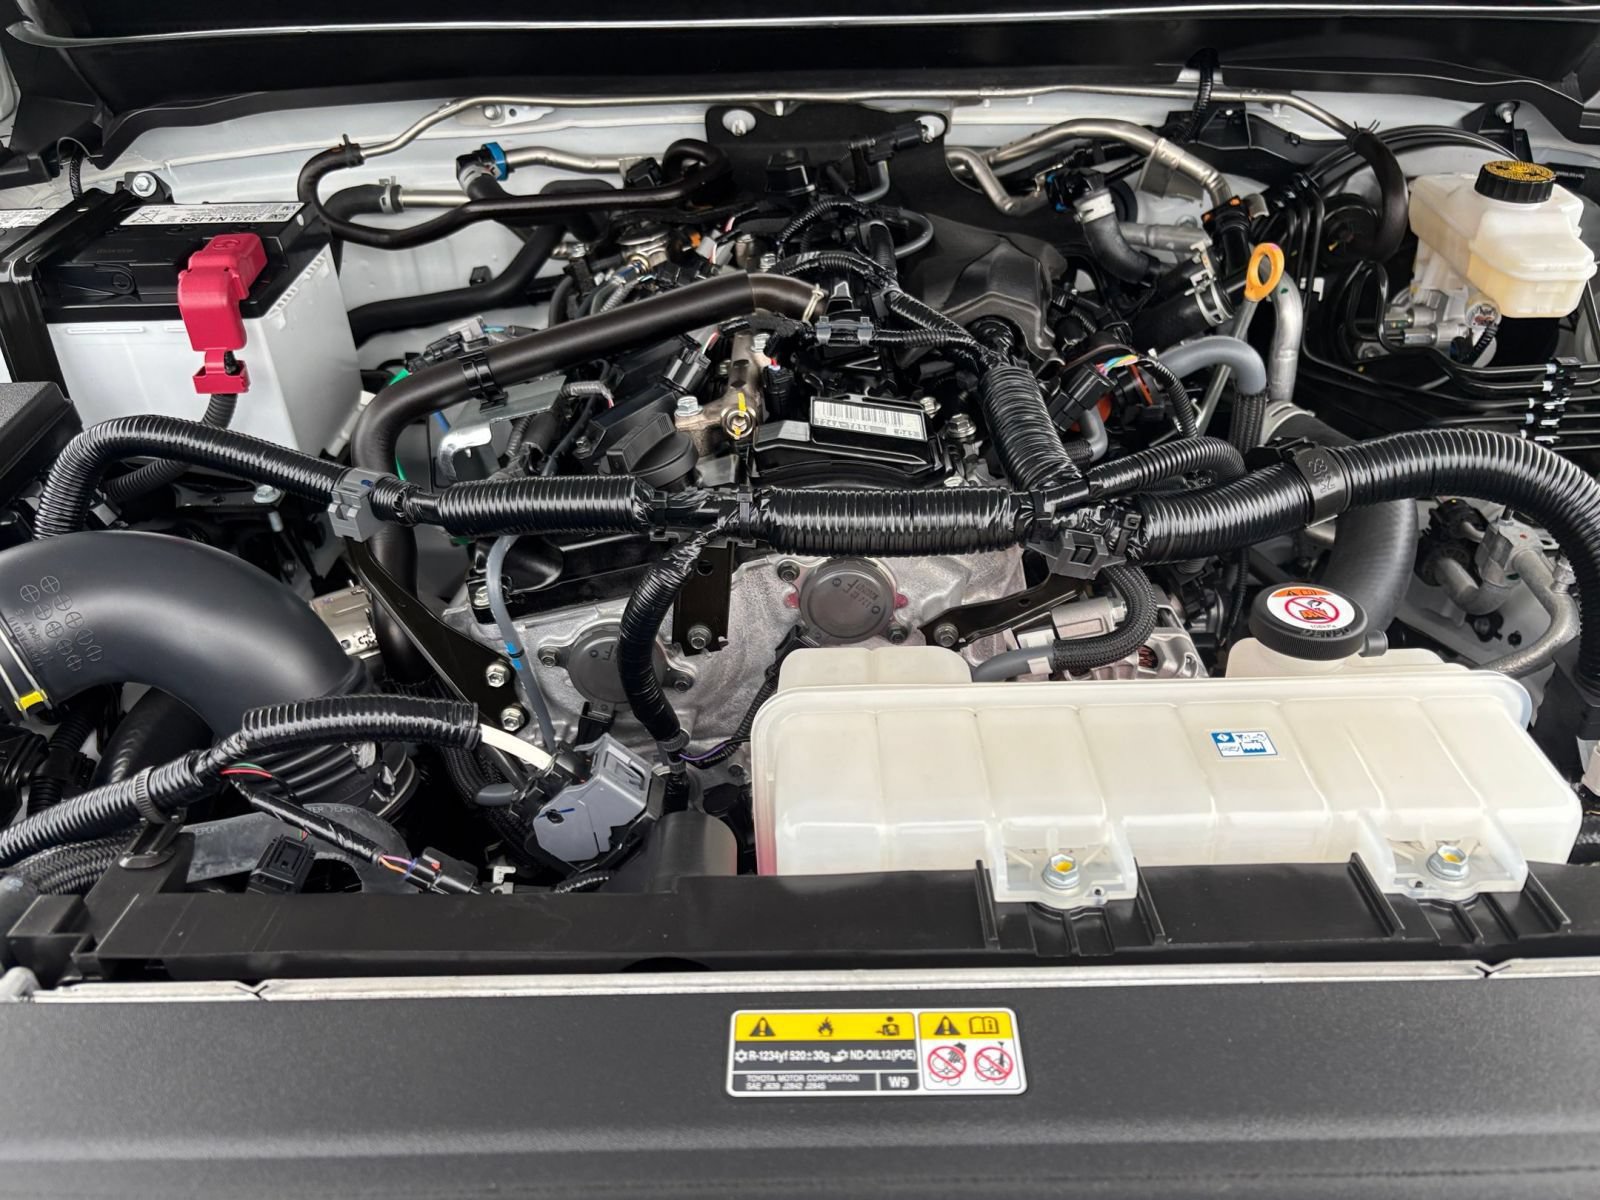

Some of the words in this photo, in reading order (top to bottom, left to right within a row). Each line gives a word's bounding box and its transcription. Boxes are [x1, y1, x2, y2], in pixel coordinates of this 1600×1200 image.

[748, 1049, 788, 1064] R-1234yf
[746, 1074, 777, 1083] TOYOTA
[777, 1074, 805, 1083] MOTOR
[805, 1073, 860, 1083] CORPORATION
[887, 1075, 910, 1089] W9
